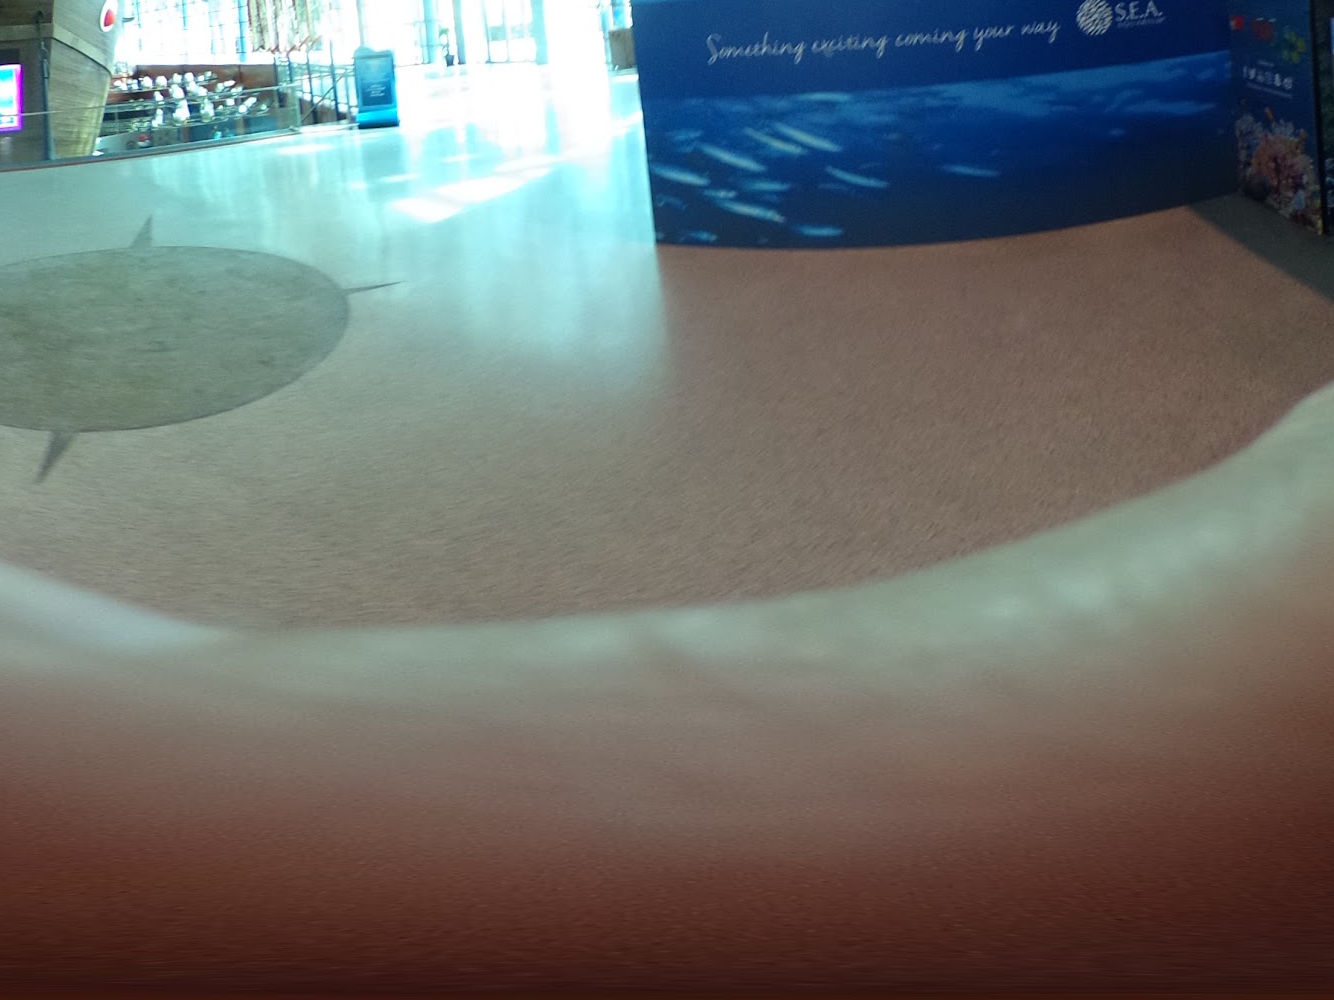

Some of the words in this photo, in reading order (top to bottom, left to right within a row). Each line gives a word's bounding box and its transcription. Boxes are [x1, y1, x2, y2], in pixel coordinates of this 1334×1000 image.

[1114, 0, 1164, 21] S.E.A.
[706, 31, 805, 65] Something
[811, 33, 889, 59] exciting
[895, 27, 967, 53] coming
[973, 24, 1014, 51] your
[1021, 20, 1060, 44] way
